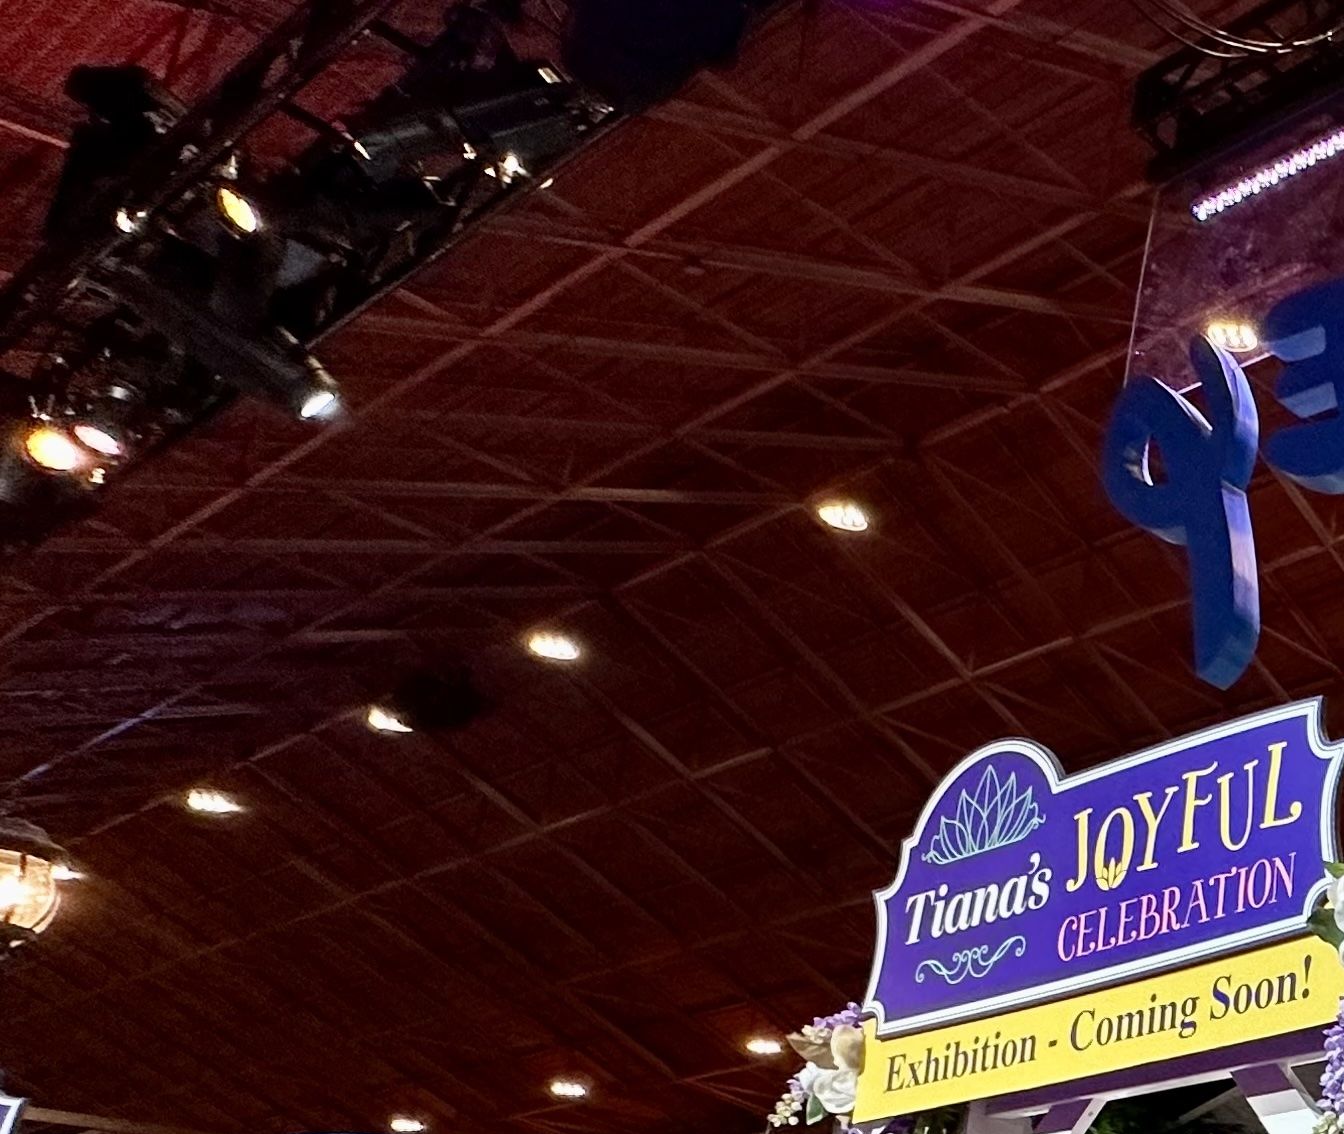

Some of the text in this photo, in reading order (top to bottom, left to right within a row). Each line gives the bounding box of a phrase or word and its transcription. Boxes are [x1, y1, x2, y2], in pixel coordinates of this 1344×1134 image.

[1066, 742, 1302, 892] JOYFUL
[905, 852, 1296, 962] Tiana's CELEBRATION
[884, 1028, 1036, 1094] Exhibition
[1069, 994, 1200, 1052] Coming
[1210, 955, 1312, 1020] Soon!
